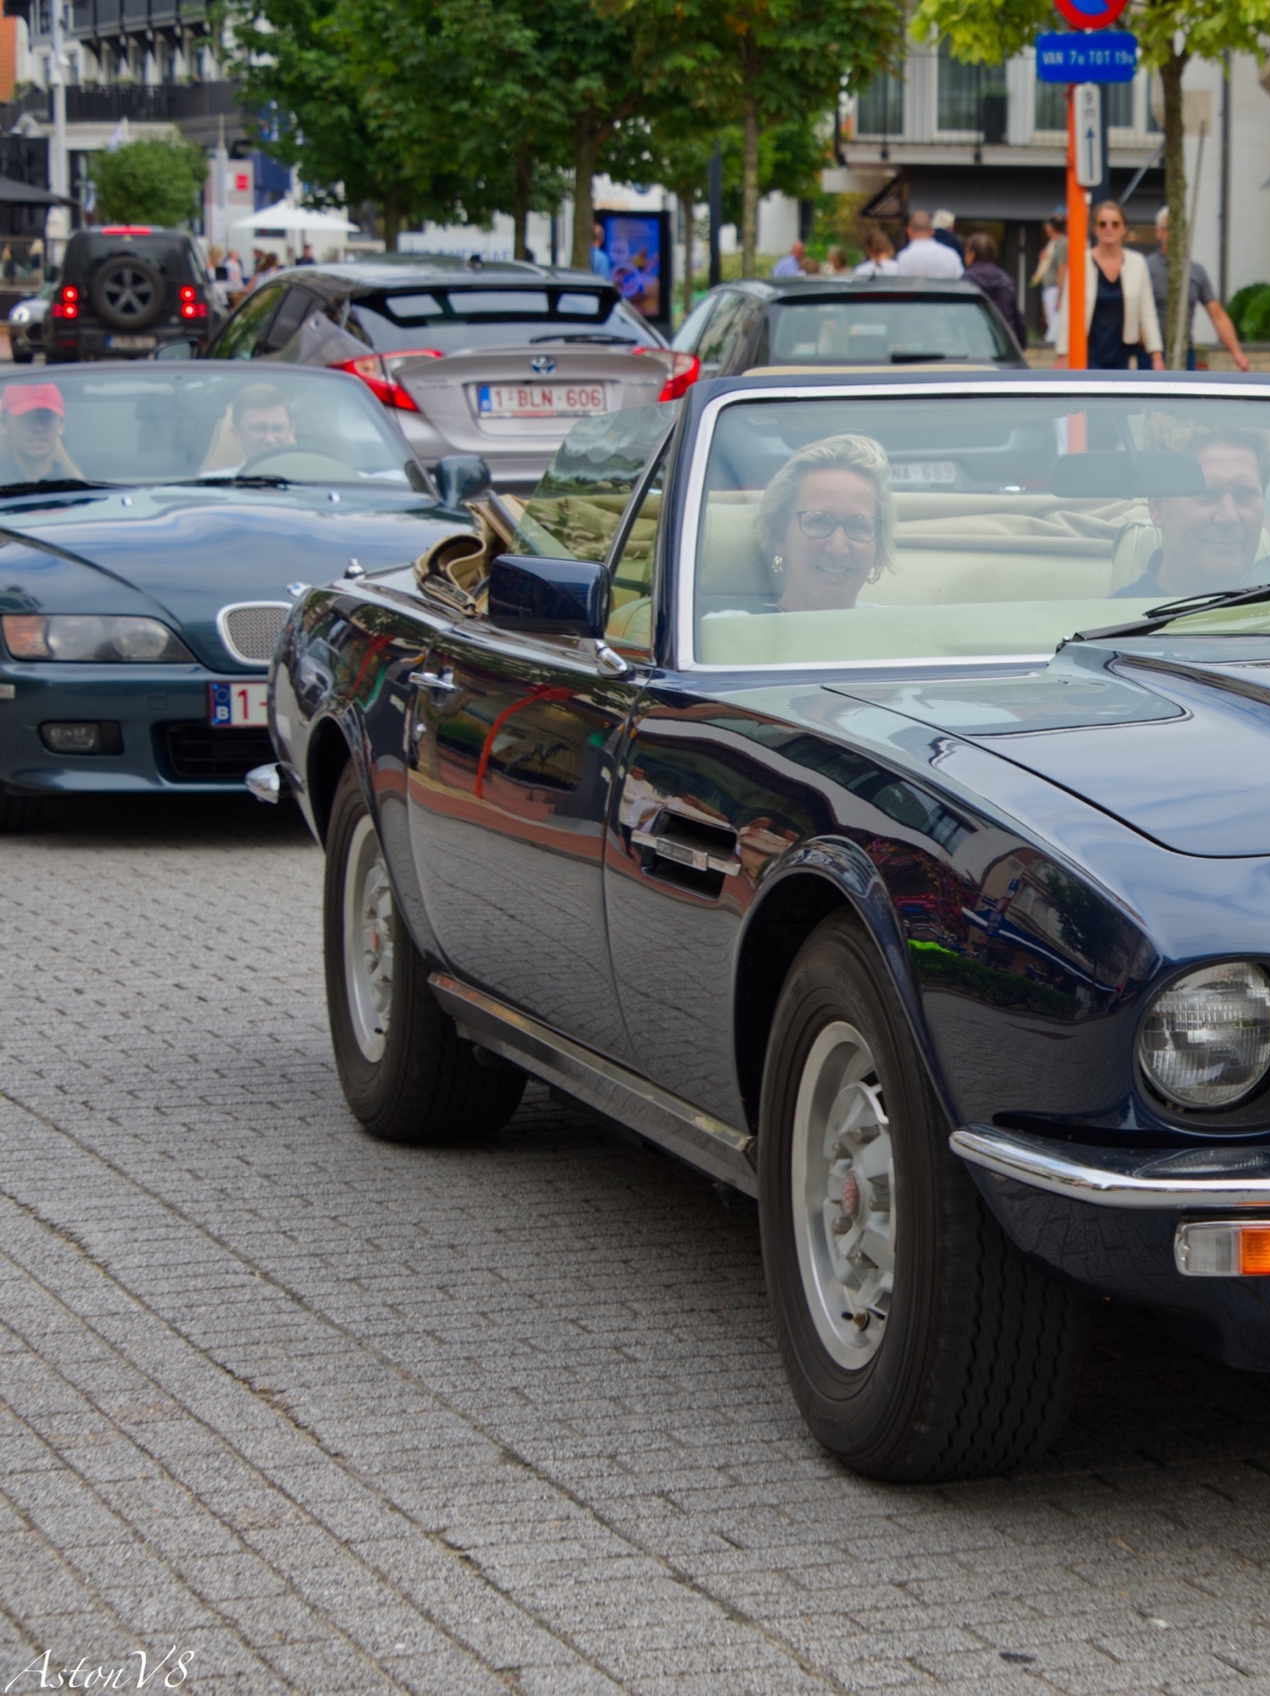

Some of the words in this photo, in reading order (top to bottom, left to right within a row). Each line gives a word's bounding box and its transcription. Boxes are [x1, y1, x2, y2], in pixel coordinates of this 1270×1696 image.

[1042, 51, 1064, 65] VAN
[1089, 51, 1110, 65] TOT
[216, 705, 229, 720] B
